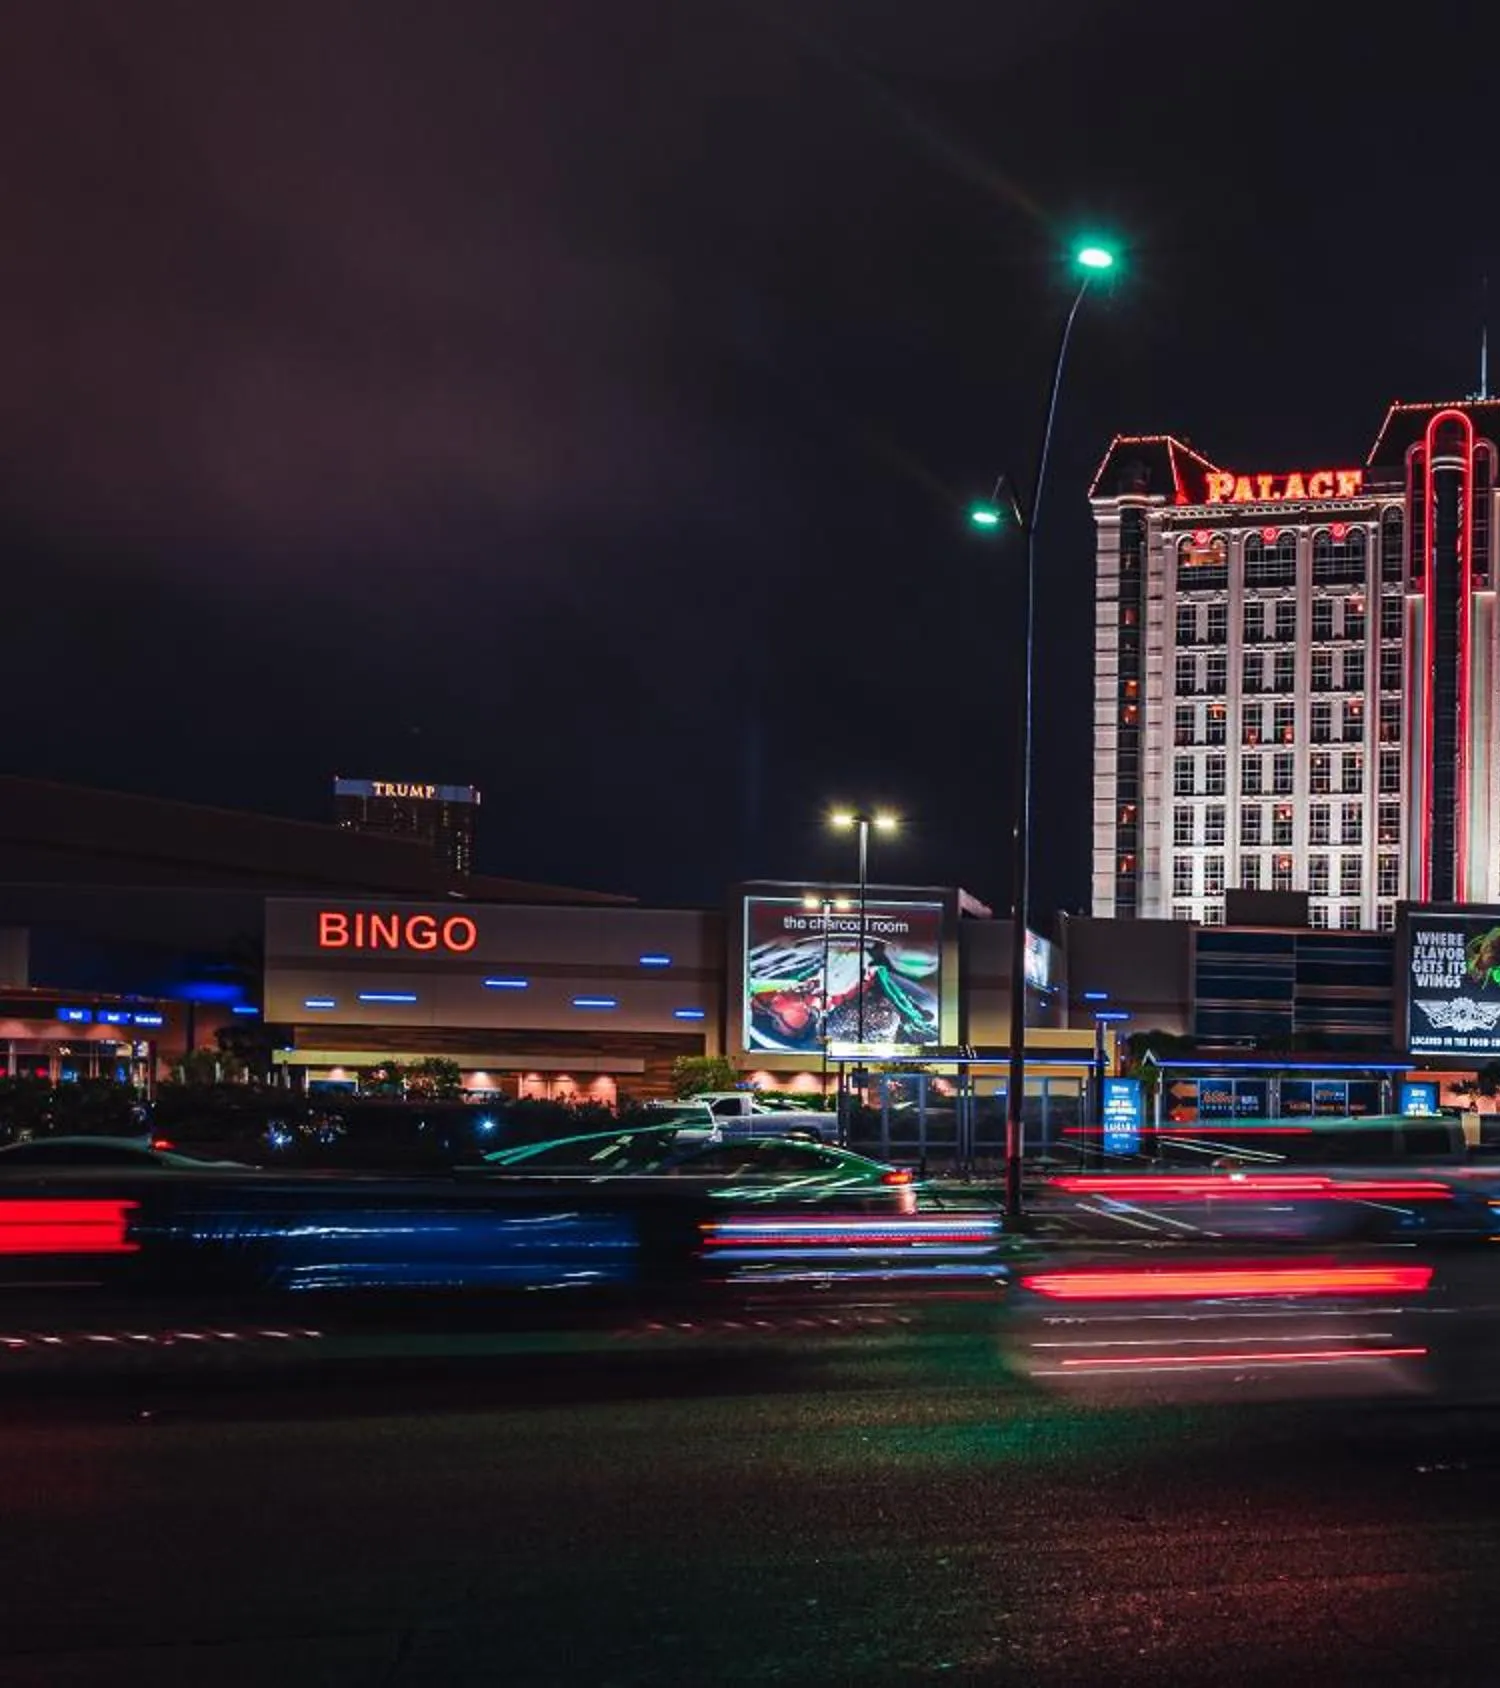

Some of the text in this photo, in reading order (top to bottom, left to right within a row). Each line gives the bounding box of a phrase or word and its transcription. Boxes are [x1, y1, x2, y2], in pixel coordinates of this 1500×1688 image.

[1205, 470, 1363, 504] PALACE
[372, 782, 435, 799] TRUMP
[319, 911, 477, 952] BINGO
[783, 915, 806, 929] the
[871, 918, 909, 933] room
[1416, 931, 1465, 946] WHERE
[1413, 945, 1465, 960] FLAVOR
[1411, 959, 1467, 975] GETS ITS
[1415, 973, 1461, 988] WINGS
